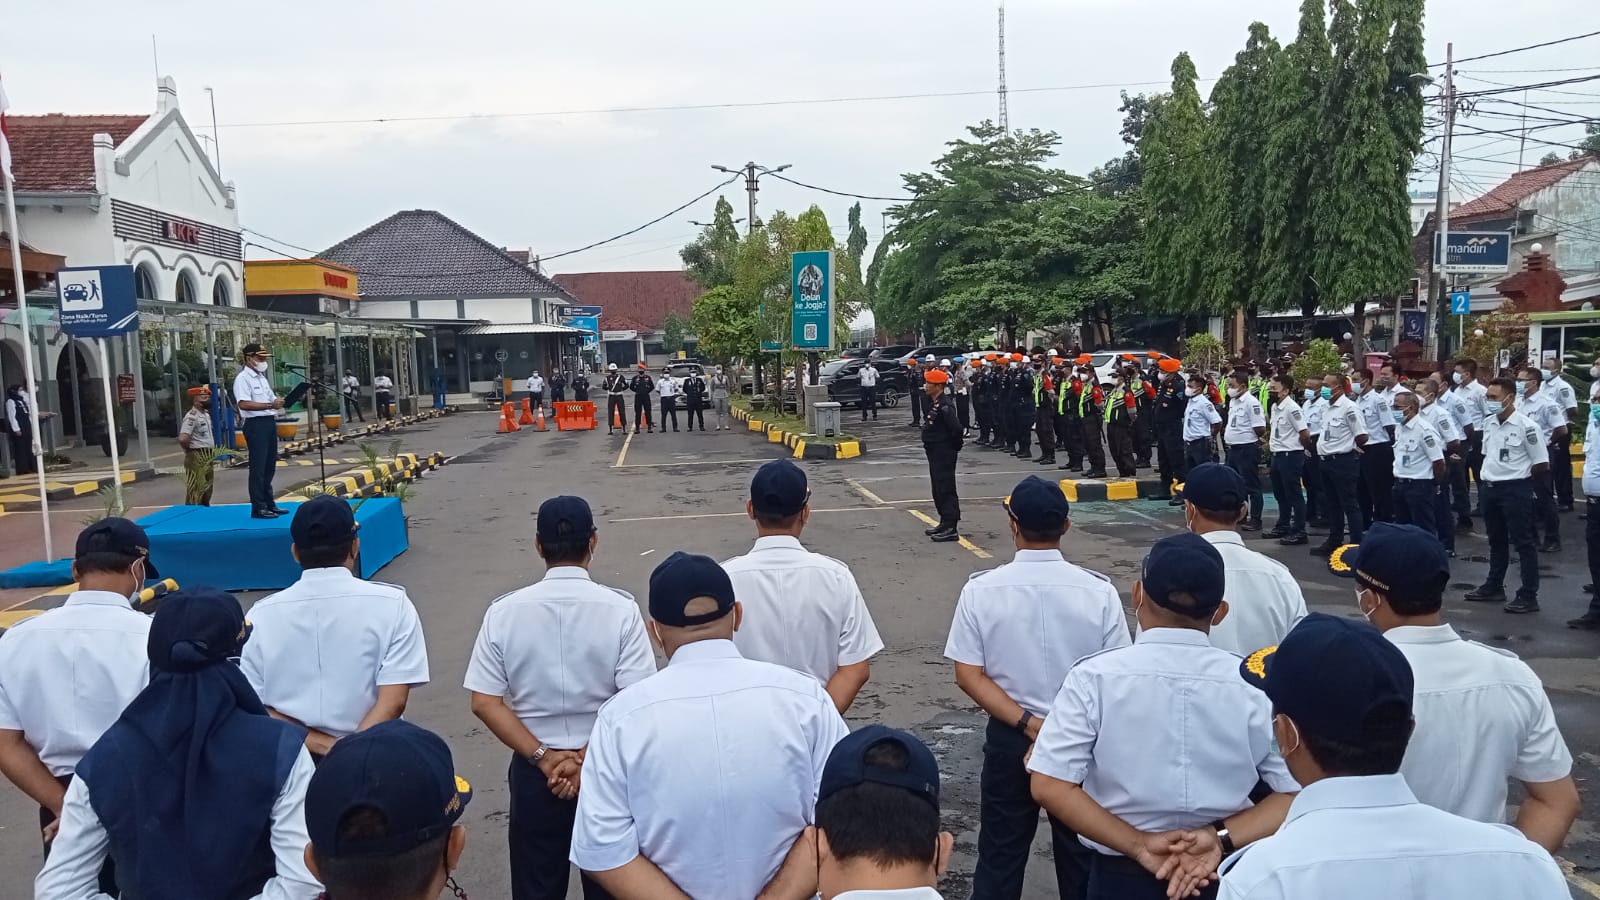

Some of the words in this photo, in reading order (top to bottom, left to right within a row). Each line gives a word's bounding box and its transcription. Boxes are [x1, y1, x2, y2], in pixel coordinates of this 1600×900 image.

[1447, 243, 1487, 254] mandiri
[801, 293, 820, 301] Dolan
[795, 301, 804, 310] ke
[805, 301, 827, 310] Jogja?
[1455, 295, 1465, 312] 2
